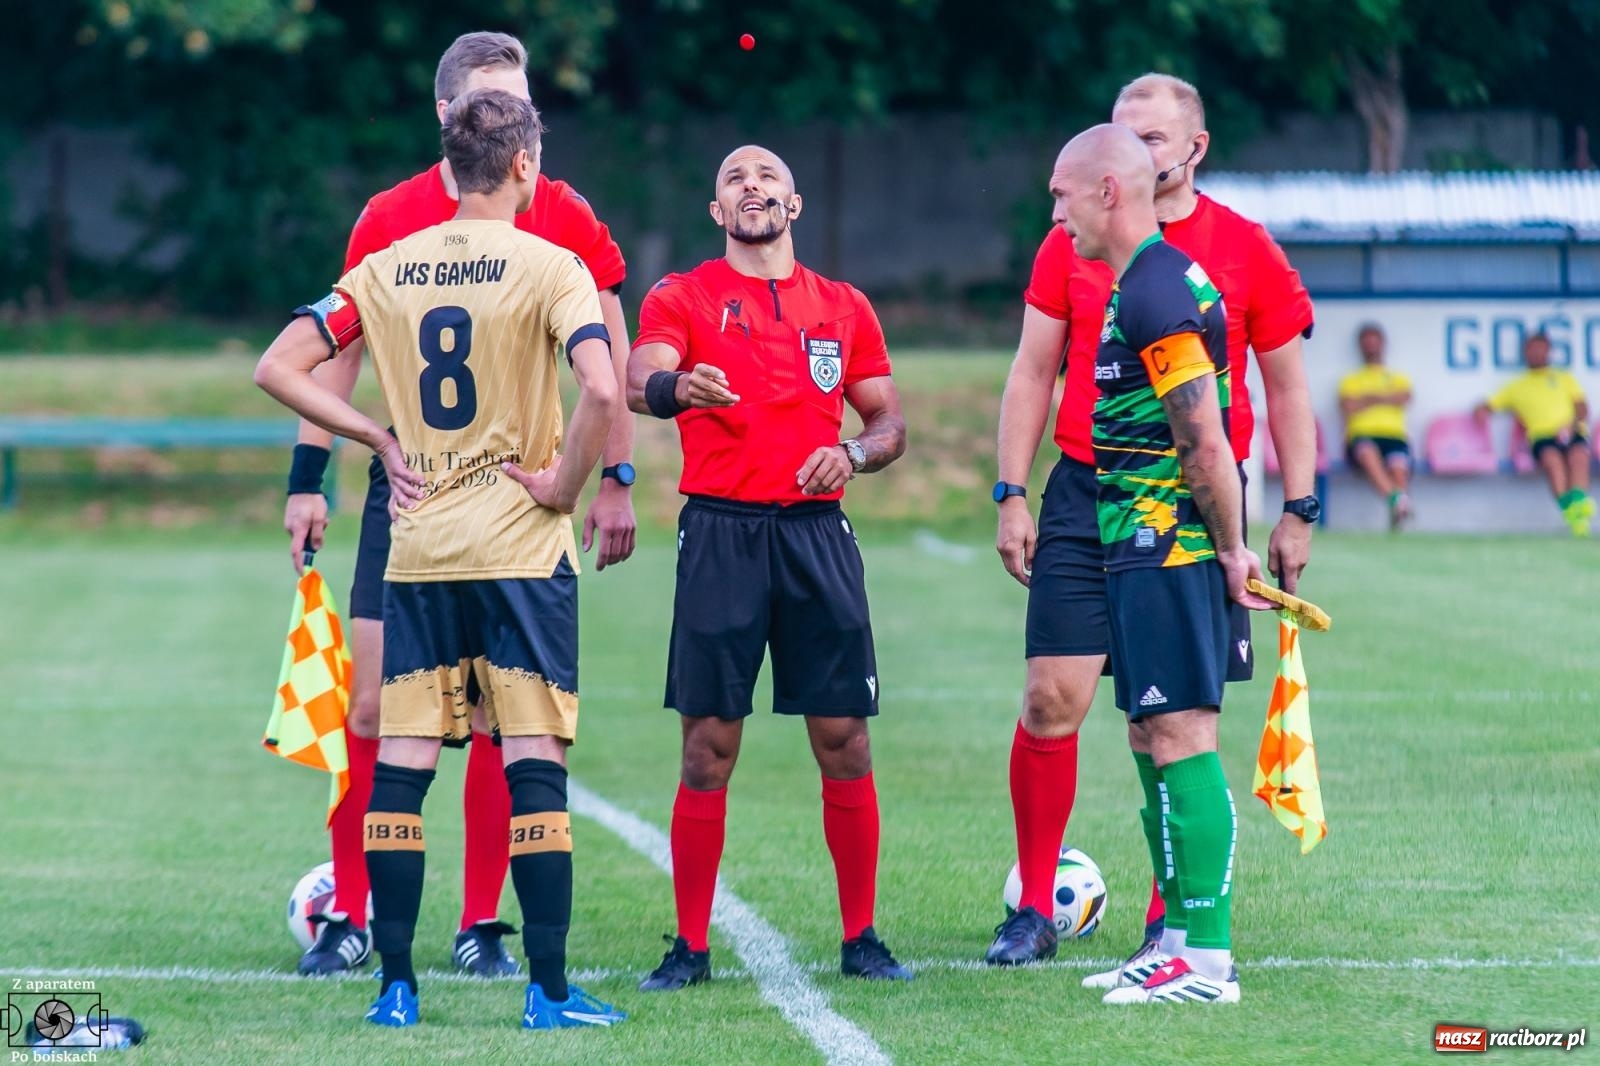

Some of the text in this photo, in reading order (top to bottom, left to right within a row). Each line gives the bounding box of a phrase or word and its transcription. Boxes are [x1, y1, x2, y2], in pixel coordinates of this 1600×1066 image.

[443, 234, 469, 247] 1936
[395, 254, 507, 287] LKS GAMÓW
[418, 305, 477, 431] 8
[1094, 361, 1121, 380] ast
[1150, 346, 1169, 376] C
[367, 824, 423, 840] 1936
